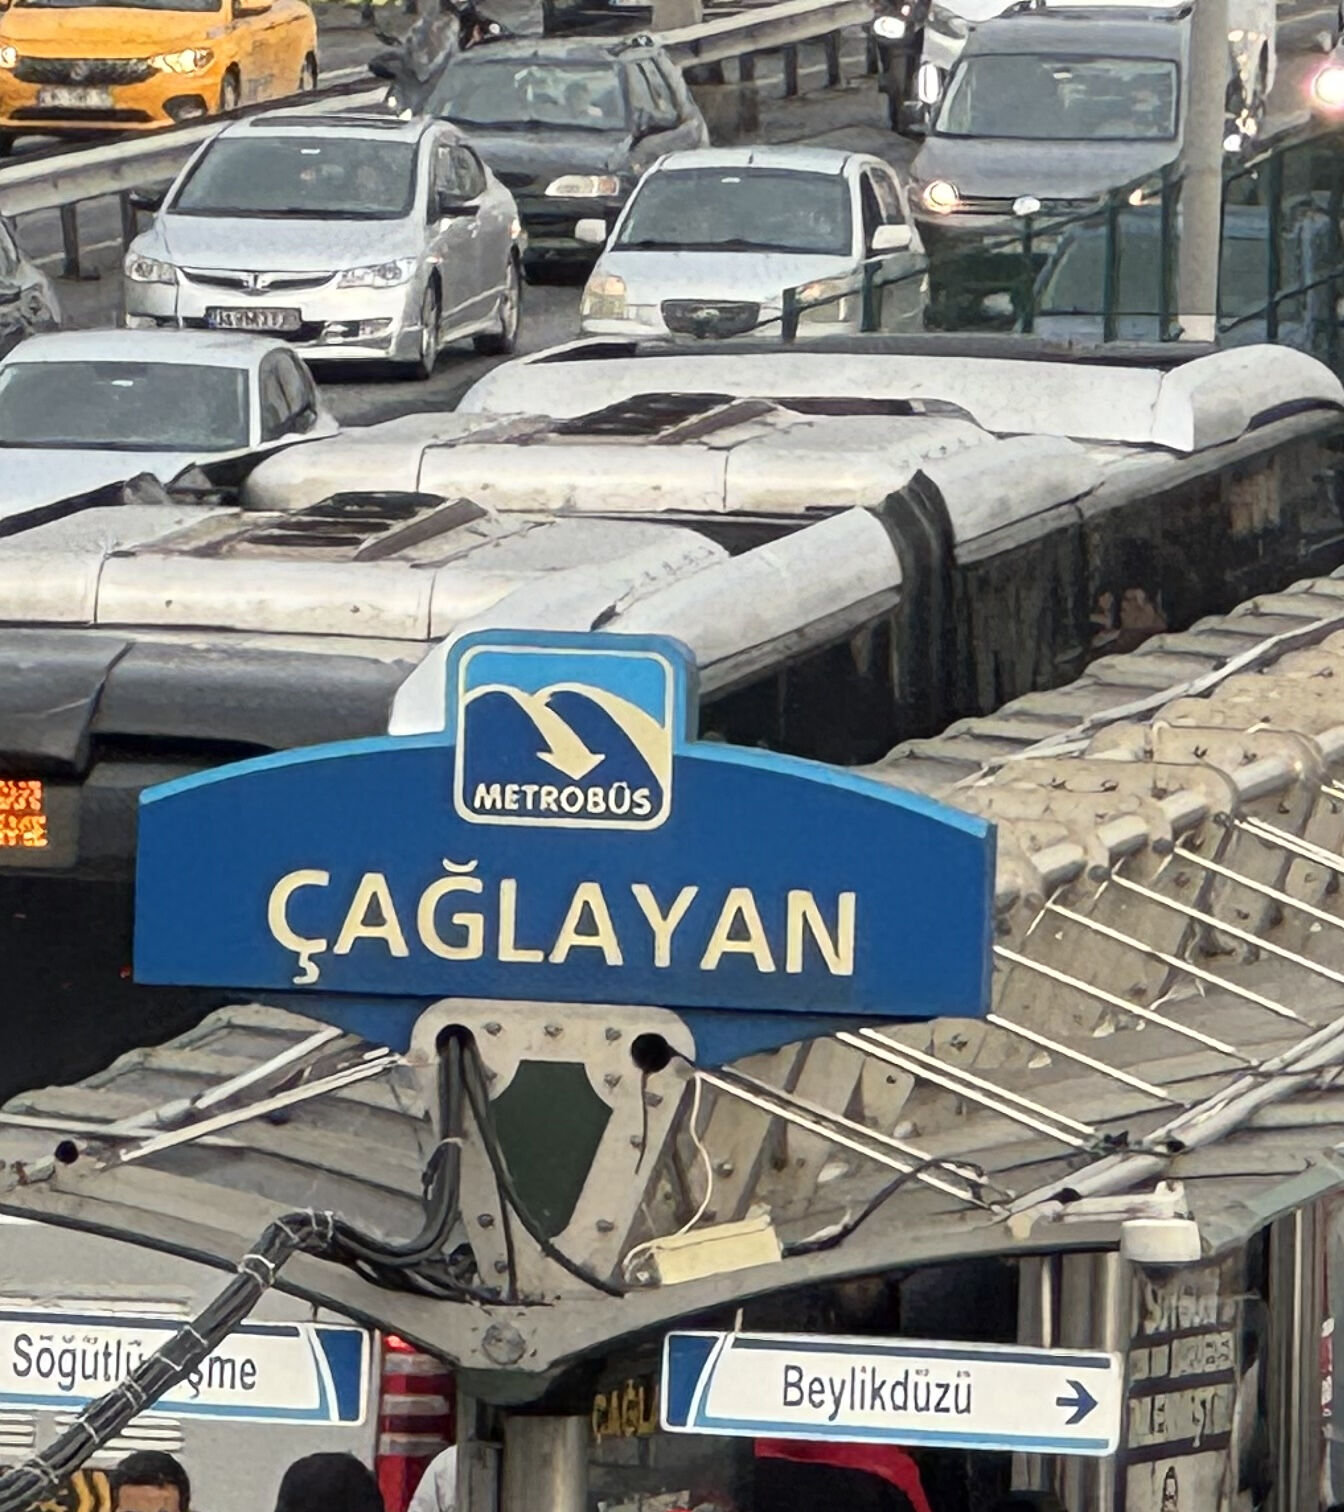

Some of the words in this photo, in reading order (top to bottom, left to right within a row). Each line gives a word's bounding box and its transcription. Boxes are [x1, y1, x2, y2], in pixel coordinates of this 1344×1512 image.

[474, 782, 652, 815] METROBÜS
[267, 858, 856, 985] ÇAĞLAYAN
[13, 1333, 257, 1399] Söğütlüşme
[782, 1364, 971, 1421] Beylikdüzü
